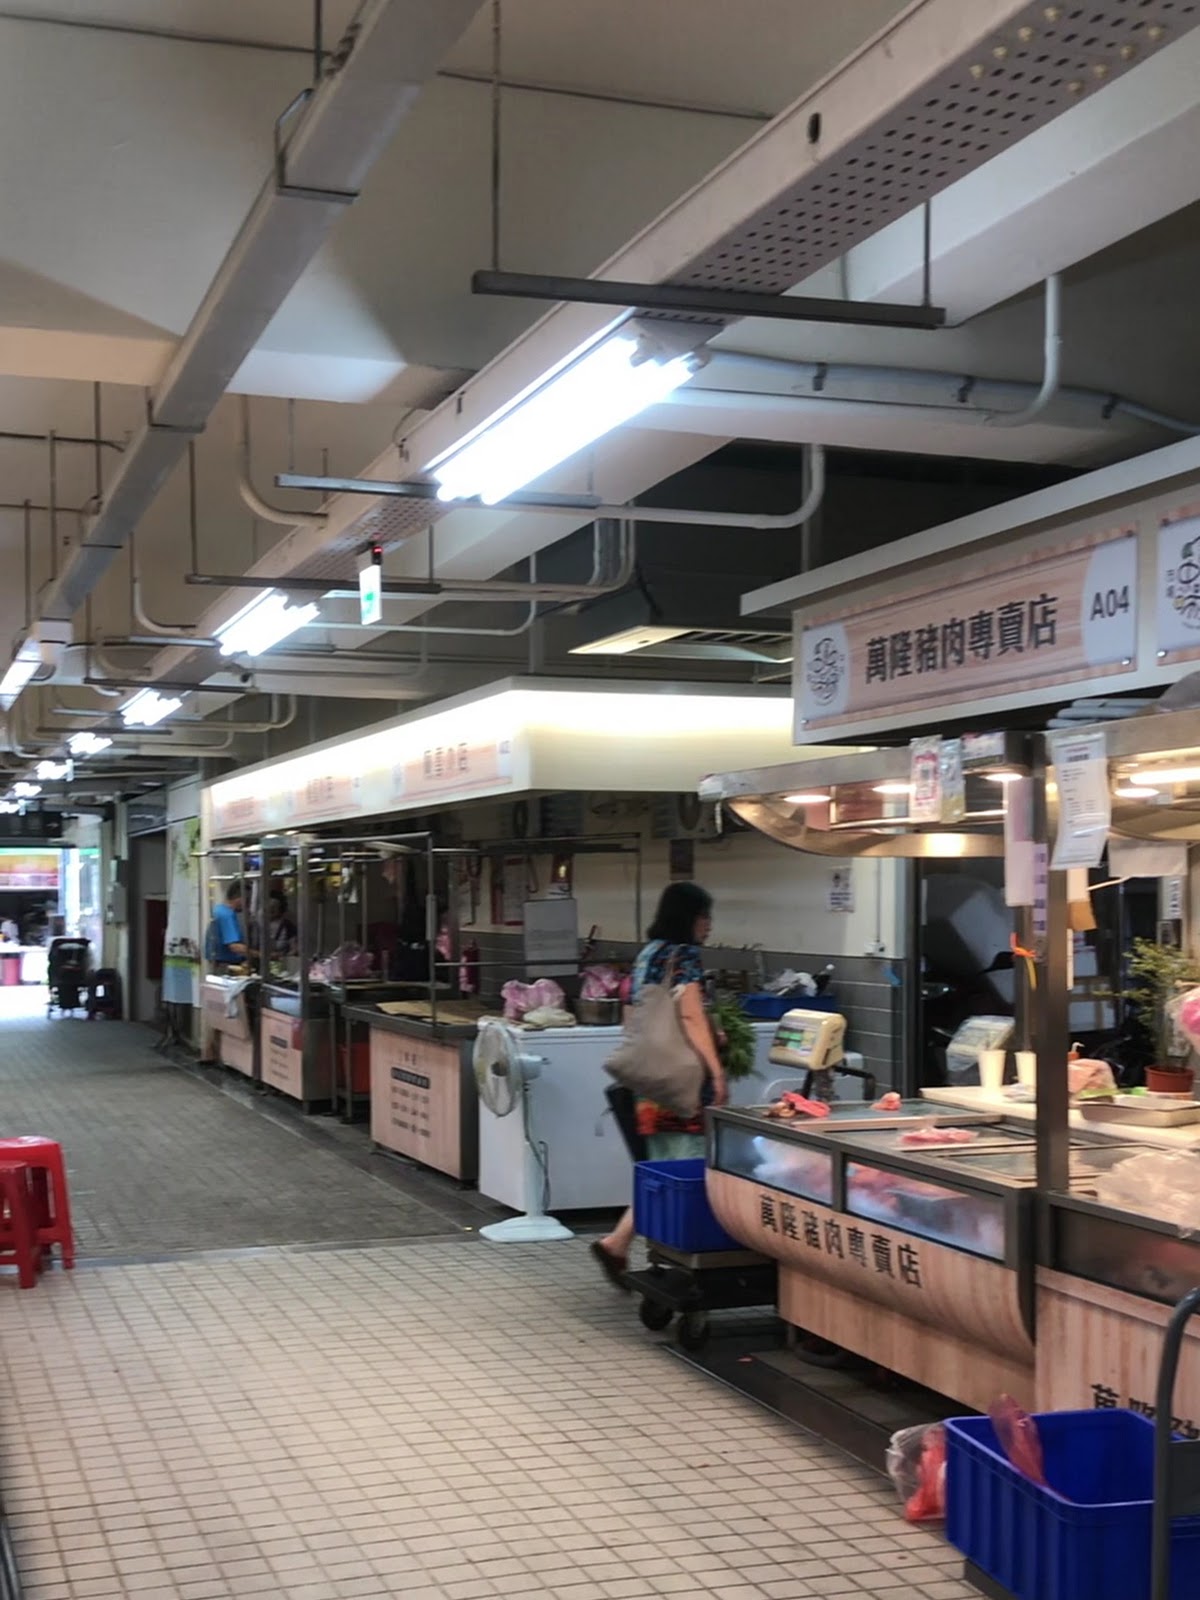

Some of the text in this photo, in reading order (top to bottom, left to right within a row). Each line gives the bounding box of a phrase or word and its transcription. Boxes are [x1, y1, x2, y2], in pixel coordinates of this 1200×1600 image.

[865, 593, 1058, 684] 萬隆豬肉專賣店
[1090, 585, 1129, 621] A04
[760, 1194, 921, 1287] 萬隆豬肉專賣店
